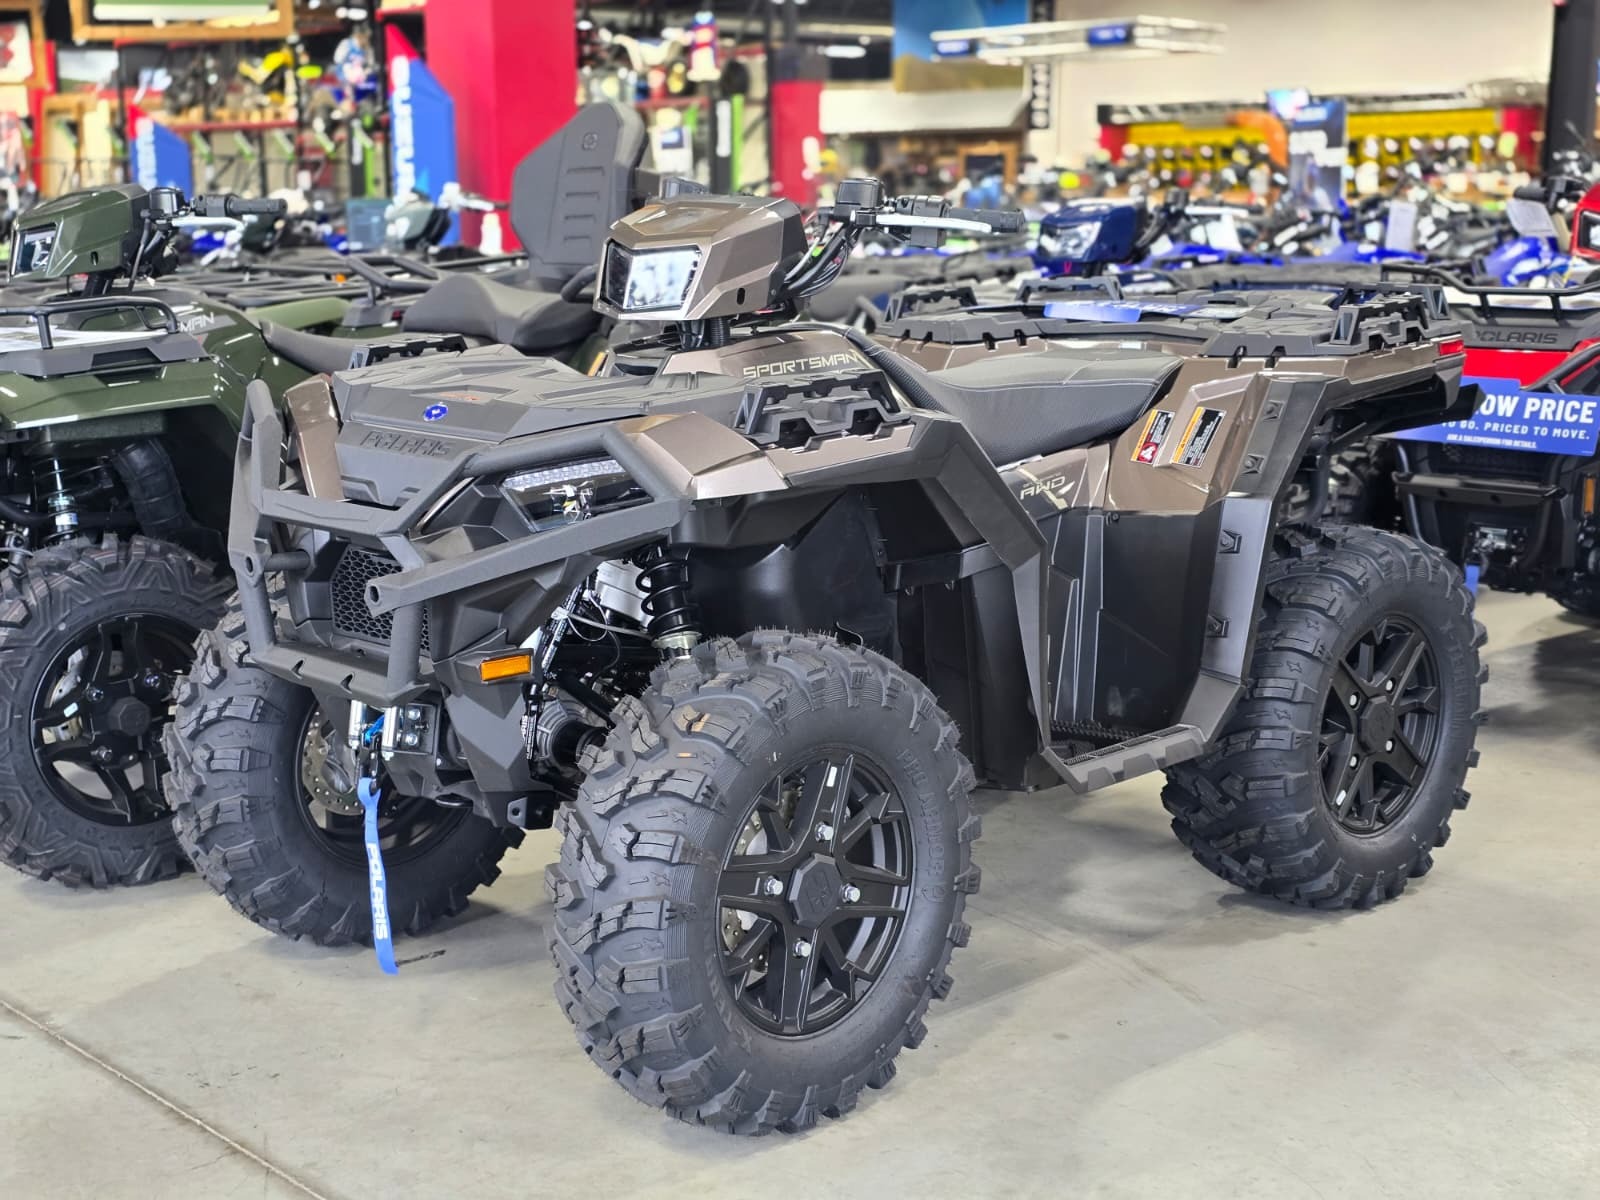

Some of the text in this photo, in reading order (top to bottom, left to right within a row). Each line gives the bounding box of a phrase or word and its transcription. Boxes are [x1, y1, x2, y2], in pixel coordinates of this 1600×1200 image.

[743, 351, 861, 379] SPORTSMAN
[1523, 396, 1597, 424] PRICE
[360, 430, 450, 457] POLARIS
[1484, 422, 1528, 435] PRICED
[1533, 426, 1548, 437] TO
[1552, 427, 1590, 440] MOVE.
[1020, 476, 1066, 501] AWD
[366, 842, 388, 940] POLARIS
